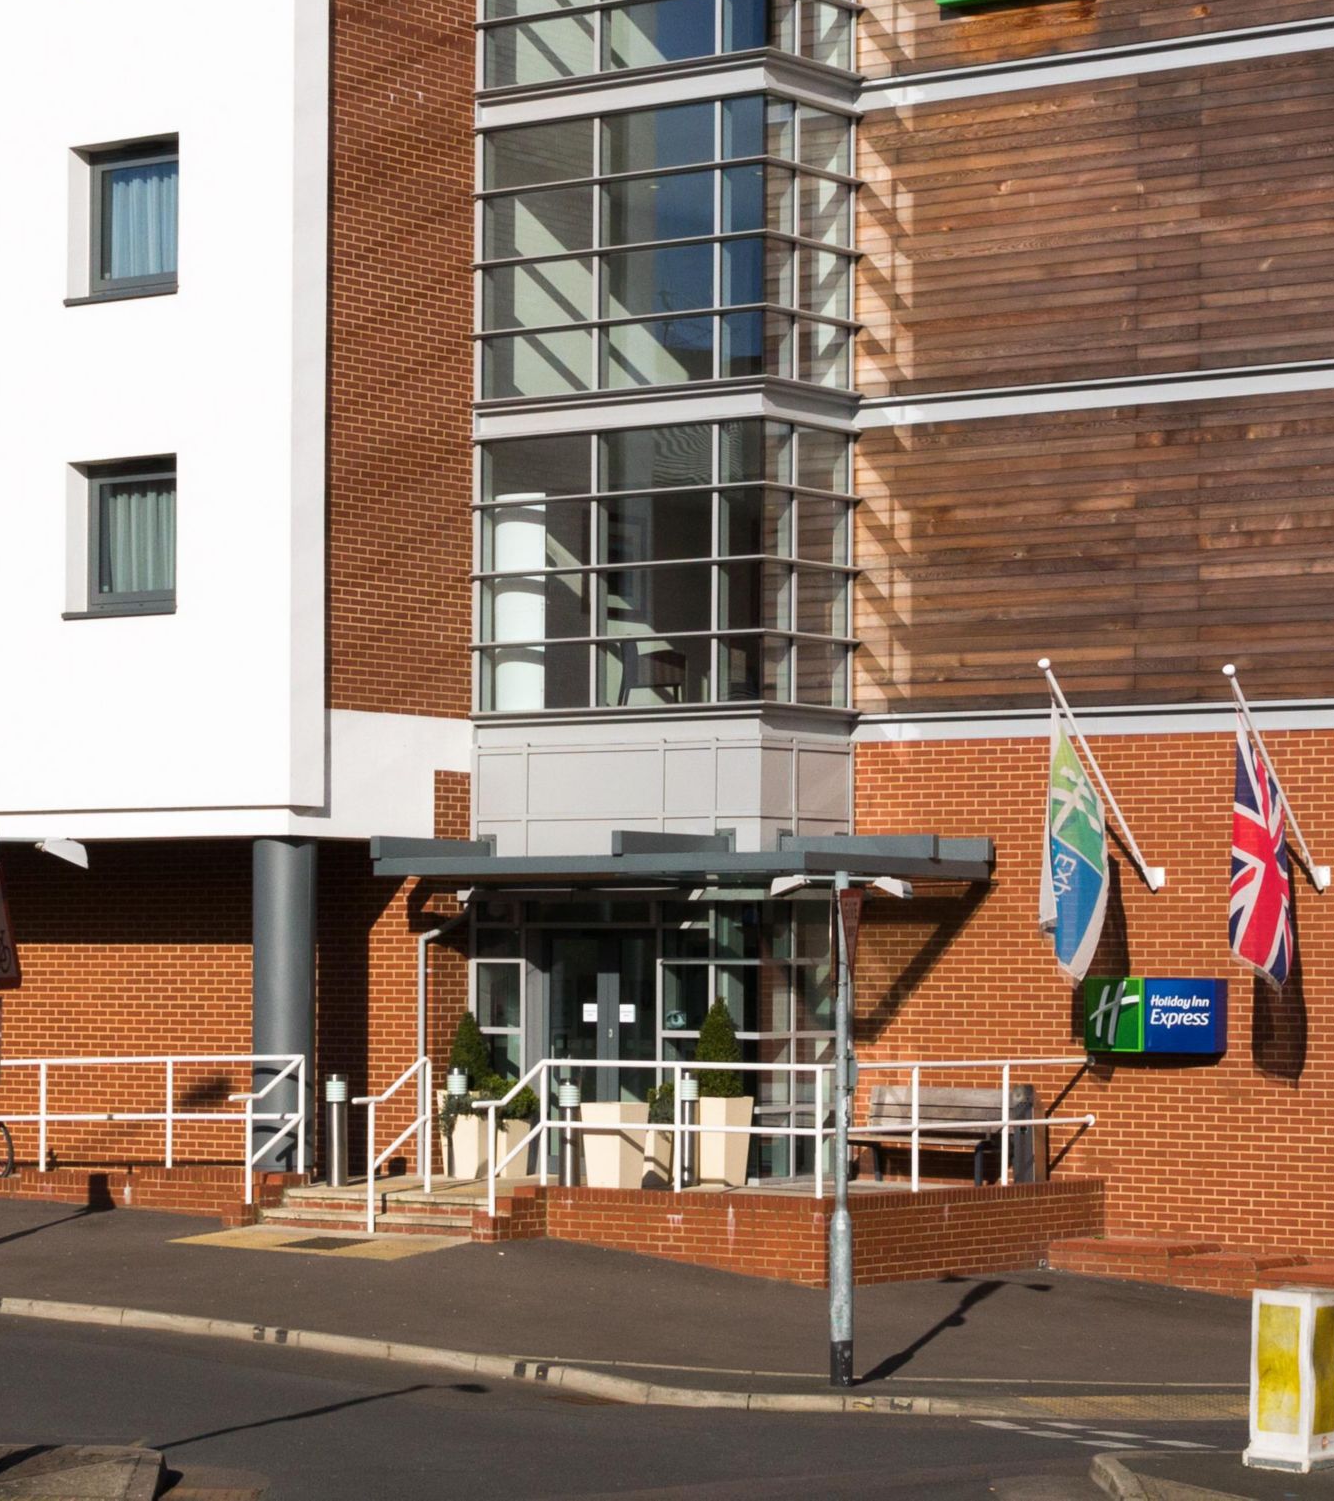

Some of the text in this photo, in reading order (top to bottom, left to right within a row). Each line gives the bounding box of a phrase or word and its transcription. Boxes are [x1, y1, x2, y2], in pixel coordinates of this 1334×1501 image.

[1150, 995, 1210, 1010] Holiday Inn
[1150, 1009, 1210, 1029] Express
